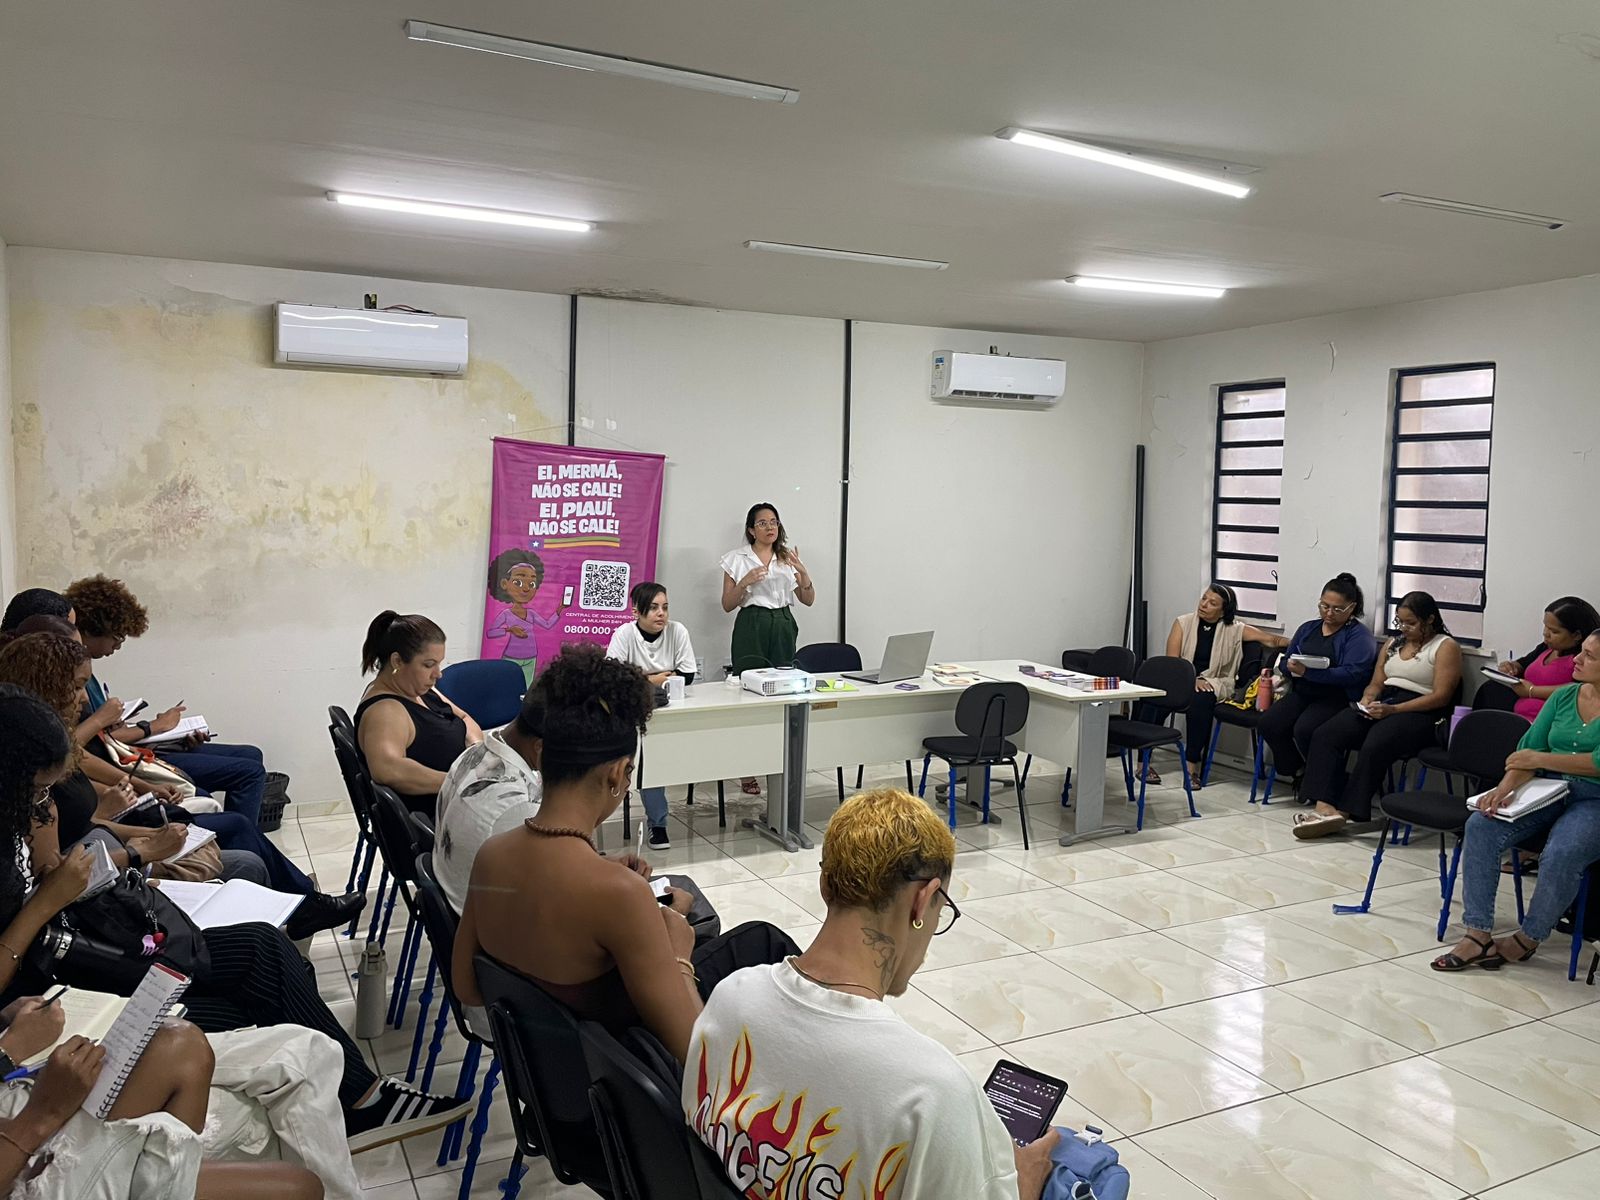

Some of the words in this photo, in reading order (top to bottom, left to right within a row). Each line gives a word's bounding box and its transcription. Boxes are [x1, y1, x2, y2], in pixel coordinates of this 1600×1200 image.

[538, 465, 557, 481] EI,
[559, 460, 622, 479] MERMÁ,
[532, 482, 562, 498] NÃO
[563, 483, 580, 497] SE
[581, 482, 622, 498] CALE!
[540, 503, 560, 519] EI,
[562, 498, 616, 517] PIAUÍ,
[529, 520, 559, 535] NÃO
[560, 520, 577, 534] SE
[579, 519, 620, 535] CALE!
[564, 625, 590, 634] 0800
[591, 626, 611, 635] 000
